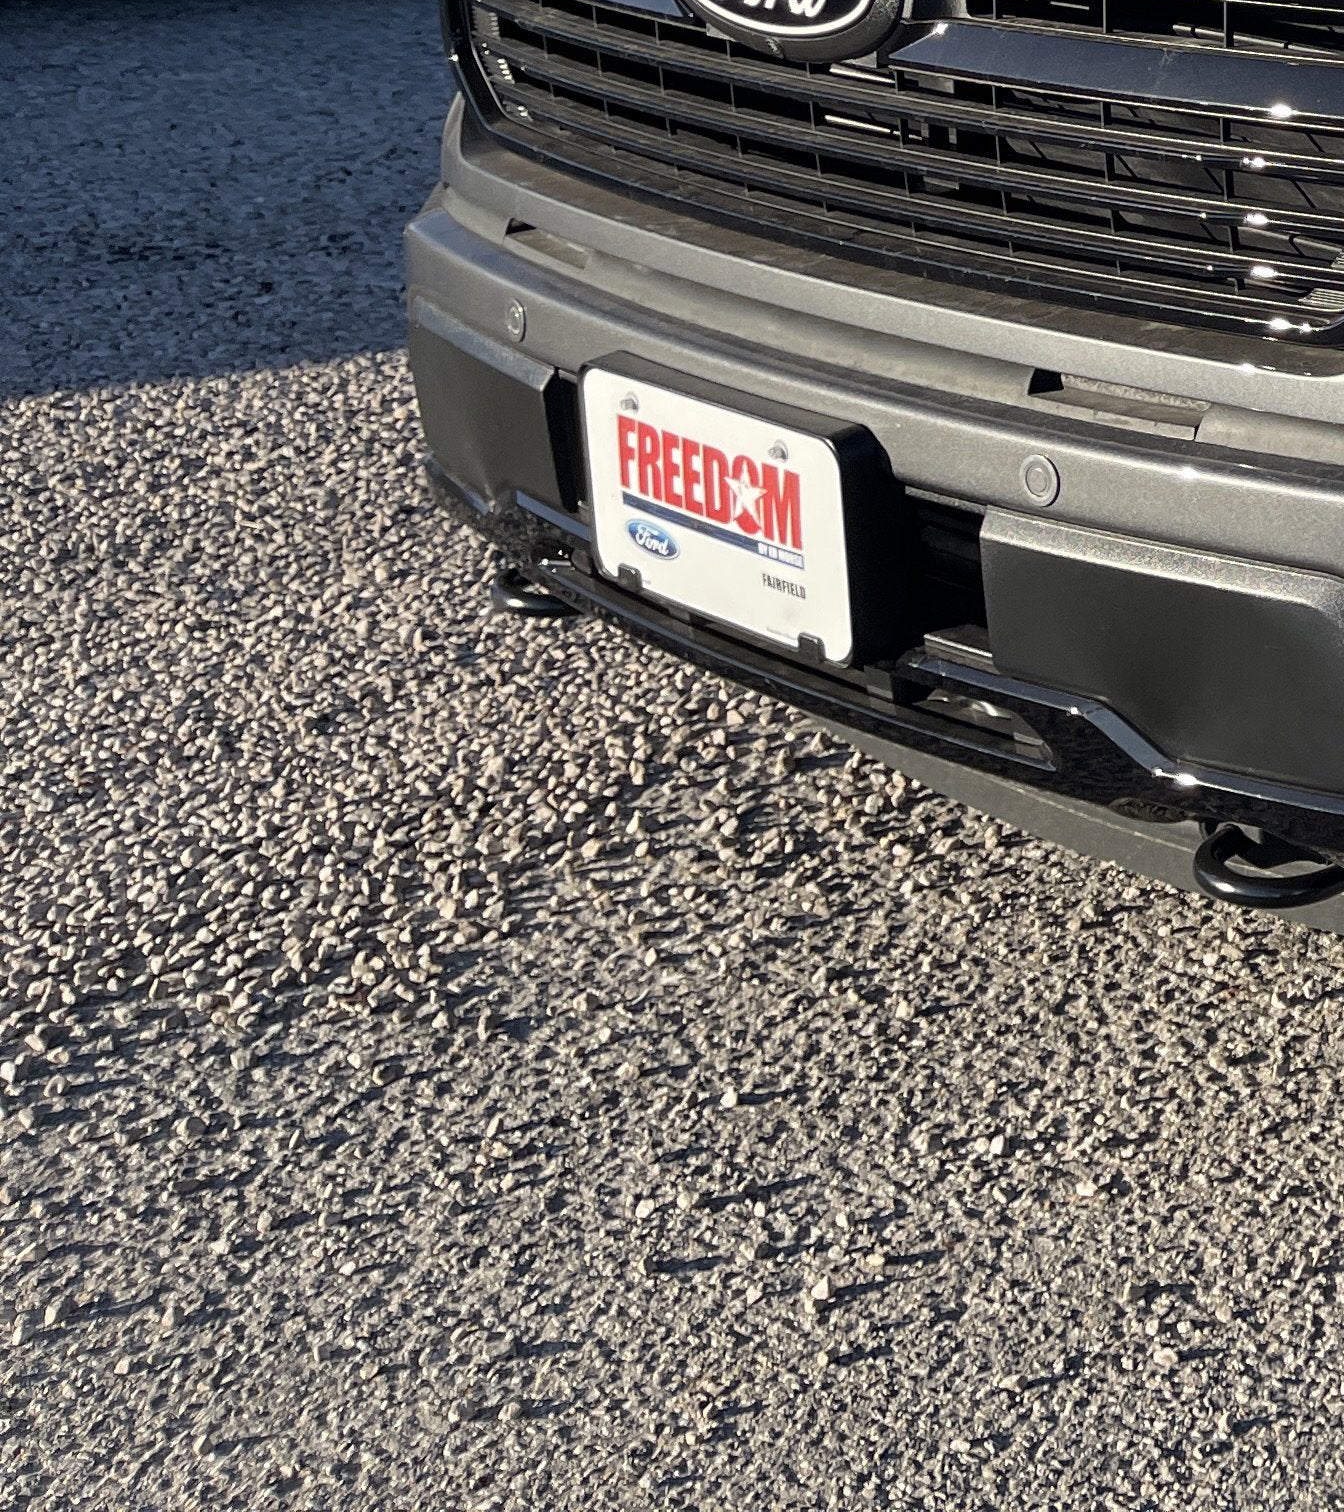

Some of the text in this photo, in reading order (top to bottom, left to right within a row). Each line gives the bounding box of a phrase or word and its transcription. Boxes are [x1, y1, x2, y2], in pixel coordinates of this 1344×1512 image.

[617, 414, 802, 551] FREEDOM
[635, 524, 669, 555] Ford
[762, 573, 806, 599] FAIRFIELD
